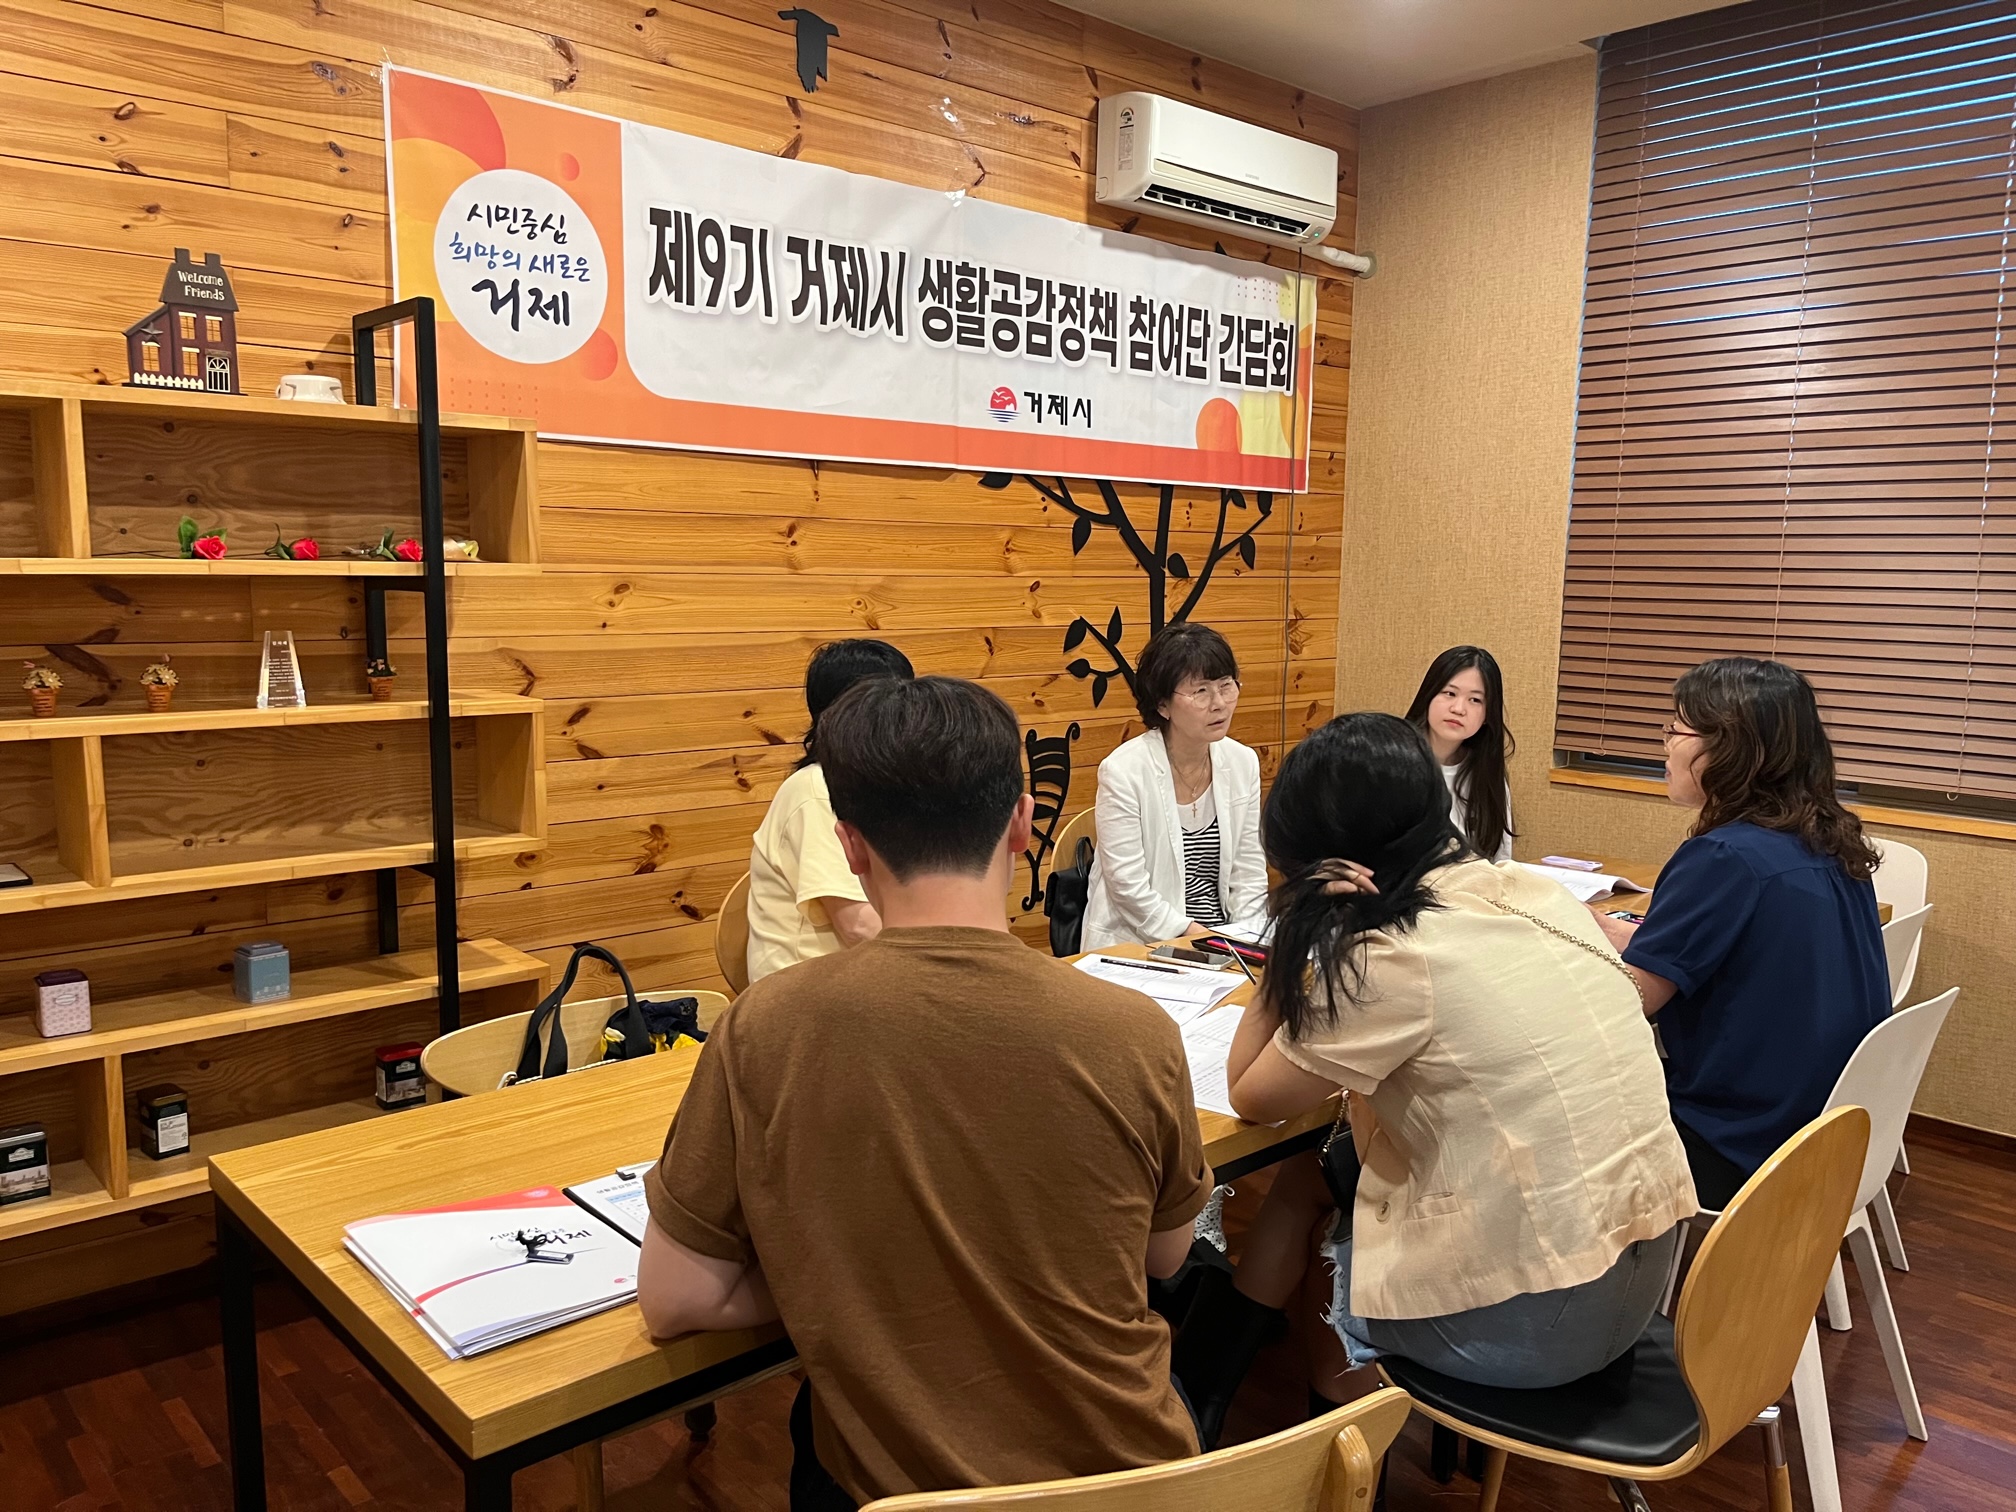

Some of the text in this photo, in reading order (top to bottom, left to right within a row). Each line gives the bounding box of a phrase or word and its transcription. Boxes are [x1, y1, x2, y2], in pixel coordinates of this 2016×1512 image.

[467, 203, 568, 244] 시민중심
[449, 231, 591, 282] 희망의 새로운
[177, 270, 224, 287] Welcome
[184, 285, 225, 301] Friends
[649, 207, 1294, 391] 제9기 거제시 생활공감정책 참여단 간담회
[471, 278, 570, 332] 거제
[1023, 391, 1092, 429] 거제시
